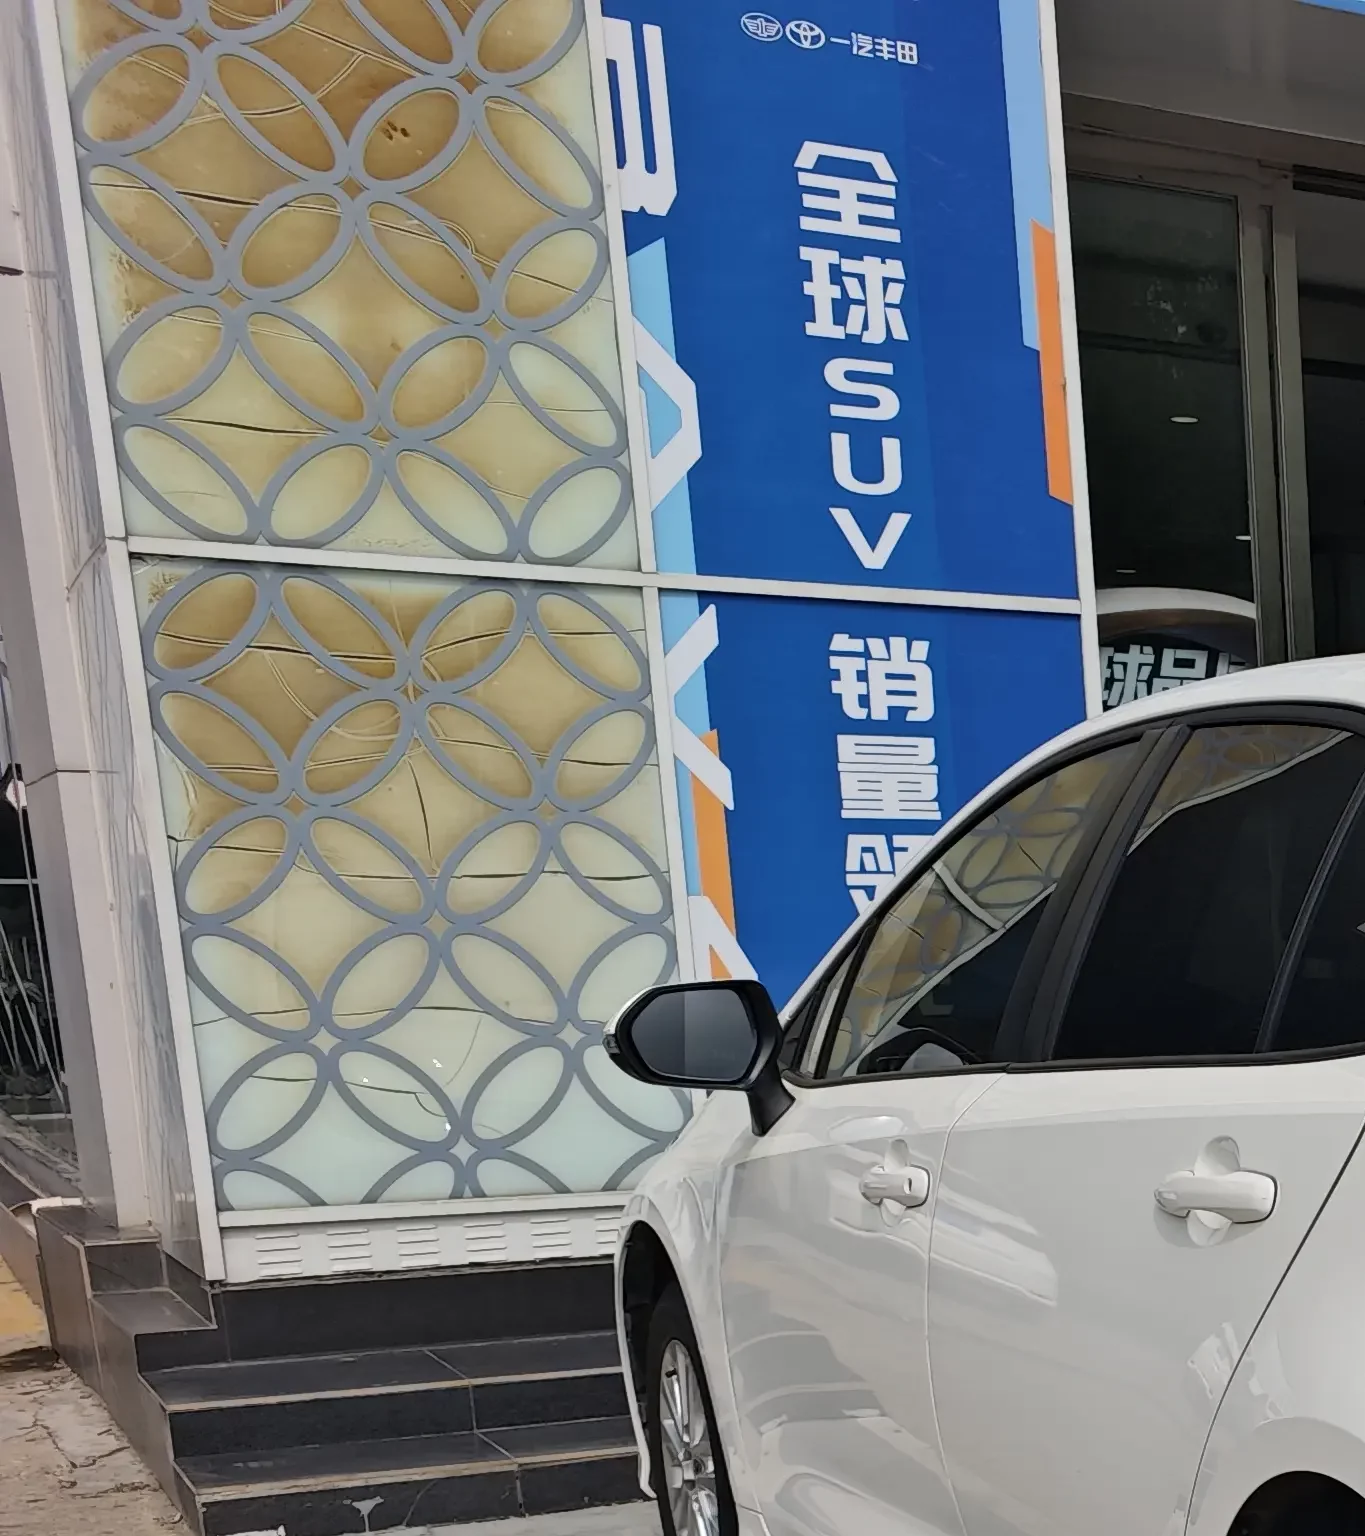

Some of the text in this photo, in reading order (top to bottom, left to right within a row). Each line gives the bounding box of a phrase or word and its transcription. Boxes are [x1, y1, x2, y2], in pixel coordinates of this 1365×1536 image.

[829, 31, 919, 65] 一汽丰田
[793, 140, 911, 571] 全球SUV
